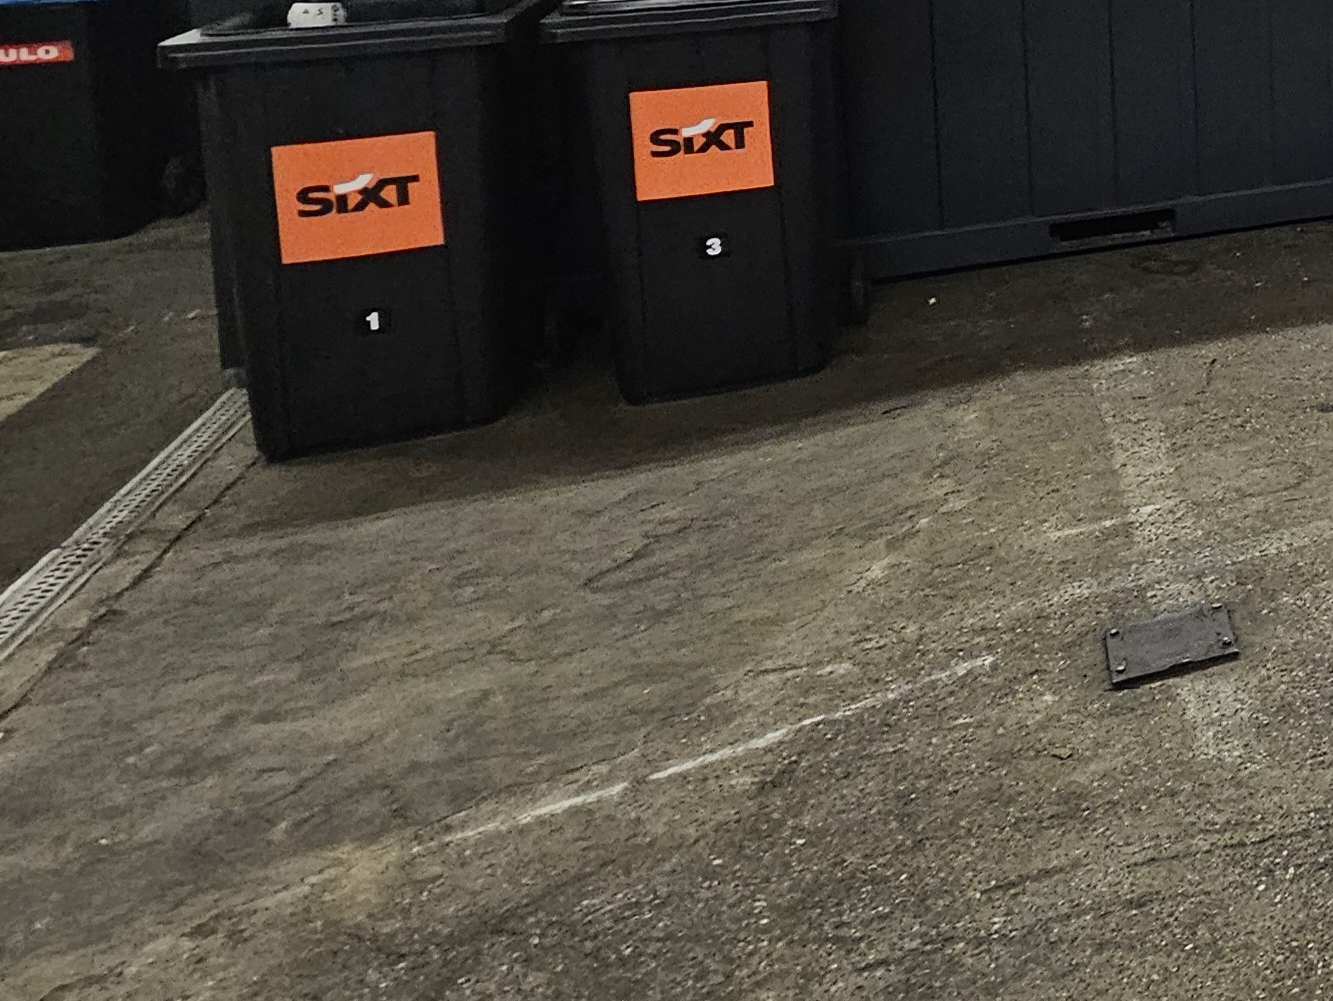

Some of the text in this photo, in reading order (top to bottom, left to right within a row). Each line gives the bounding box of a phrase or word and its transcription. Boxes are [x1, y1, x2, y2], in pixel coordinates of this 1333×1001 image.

[649, 117, 755, 158] SIXT
[295, 172, 420, 218] SIXT
[705, 237, 722, 256] 3
[365, 311, 380, 331] 1
